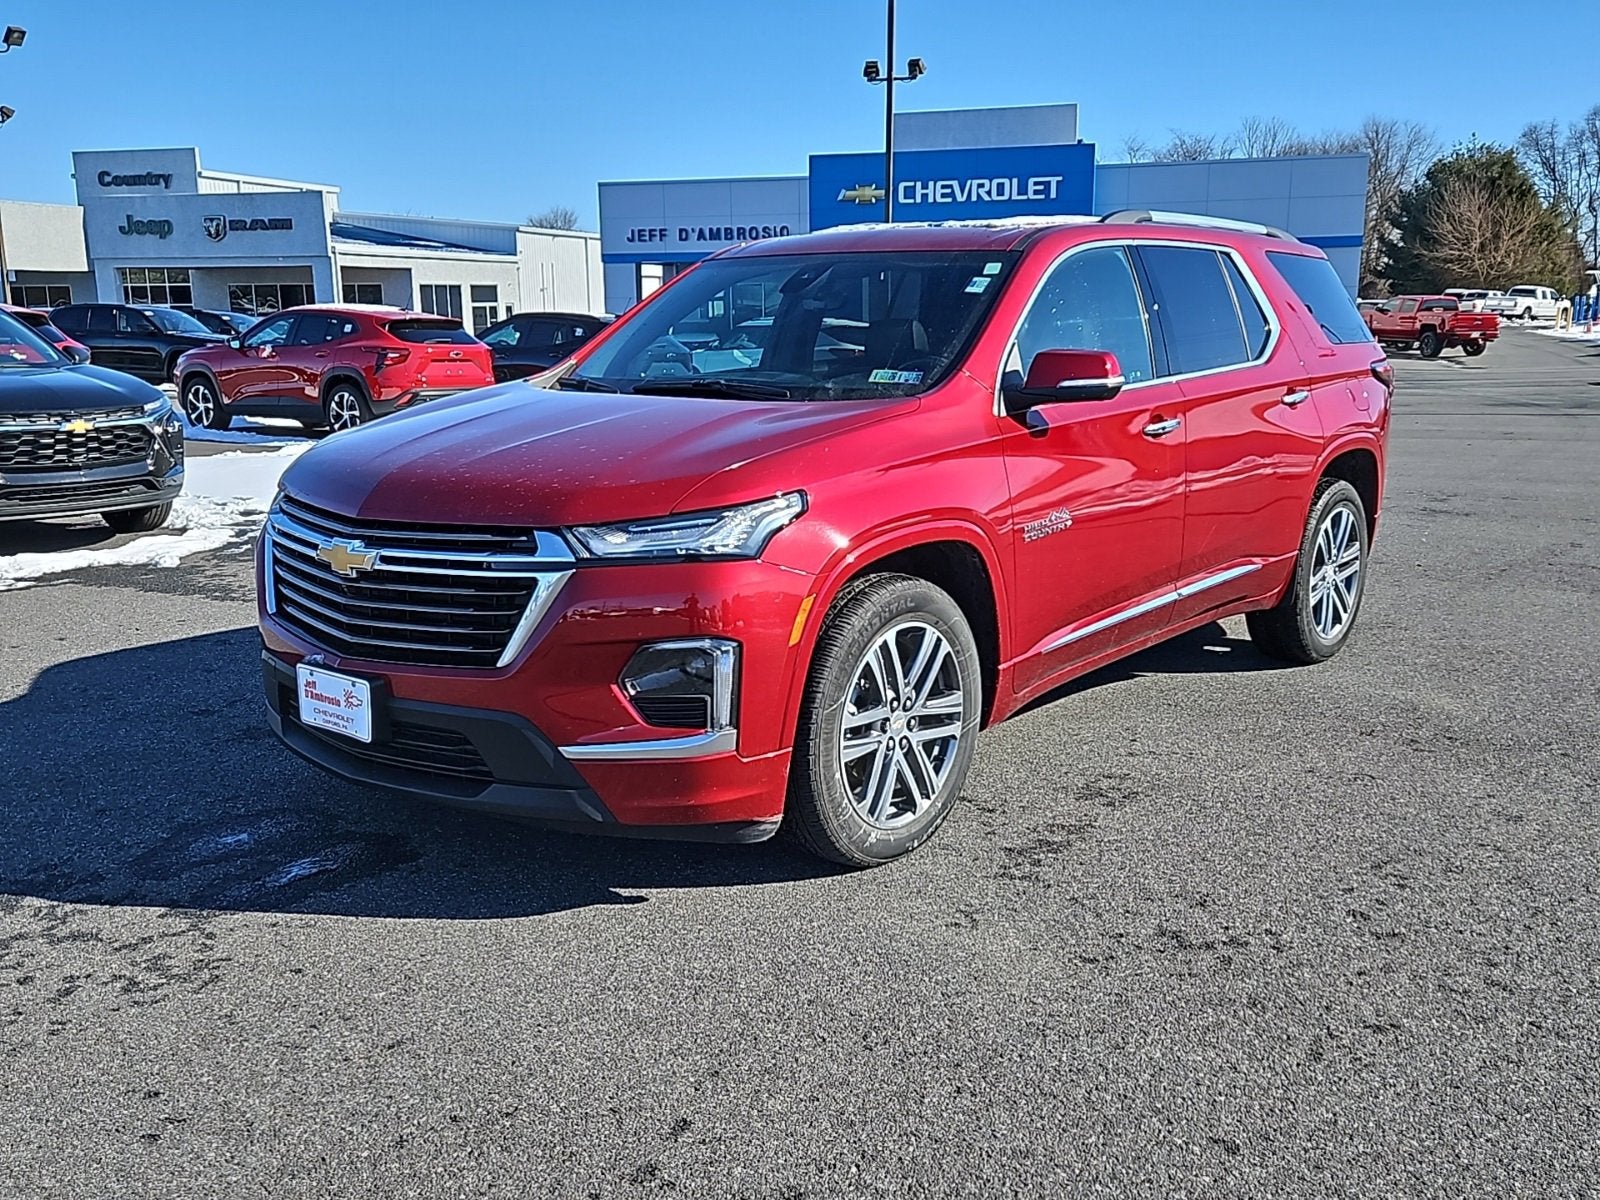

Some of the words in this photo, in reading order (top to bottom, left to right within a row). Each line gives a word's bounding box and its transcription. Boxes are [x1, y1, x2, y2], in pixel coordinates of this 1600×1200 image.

[97, 170, 173, 189] Country
[898, 176, 1063, 204] CHEVROLET
[118, 214, 174, 239] Jeep
[228, 217, 293, 232] RAM
[626, 228, 668, 243] JEFF
[678, 225, 790, 242] D'AMBROSIO
[314, 707, 355, 724] CHEVROLET
